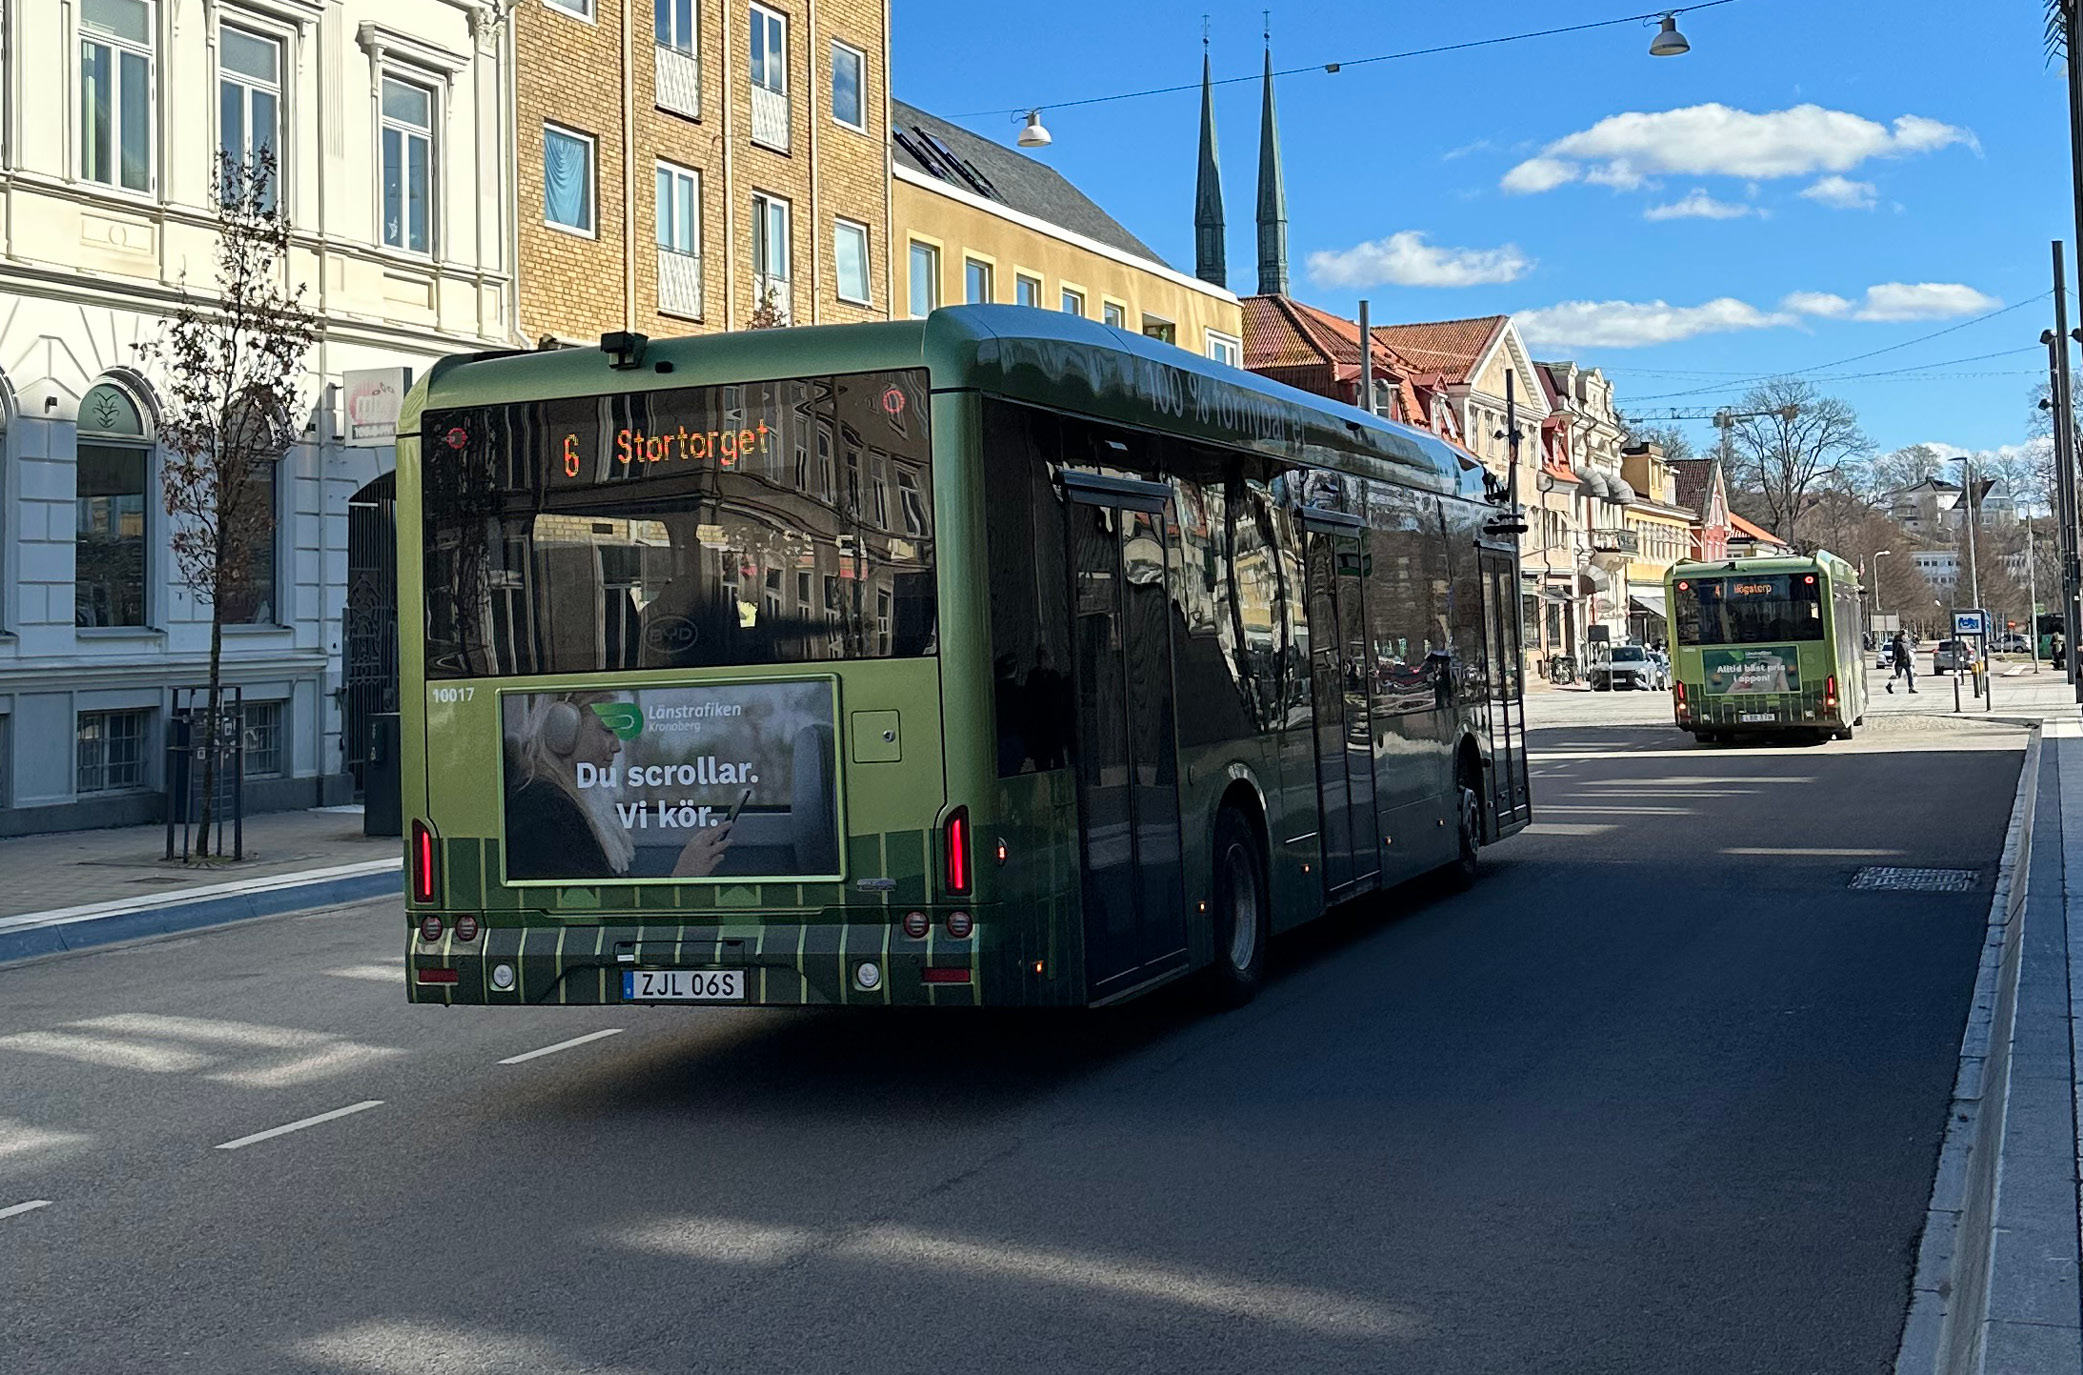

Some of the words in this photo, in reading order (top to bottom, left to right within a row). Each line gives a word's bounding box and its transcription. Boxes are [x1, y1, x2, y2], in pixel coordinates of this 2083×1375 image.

[1145, 361, 1183, 418] 100
[1188, 372, 1209, 424] %
[563, 433, 579, 478] 6
[617, 418, 768, 466] Stortorget
[649, 627, 692, 642] BYD
[432, 686, 475, 703] 10017
[648, 702, 742, 720] Länstrafiken
[648, 721, 701, 733] Kronoberg
[576, 761, 617, 789] Du
[627, 756, 759, 787] scrollar.
[616, 800, 648, 829] Vi
[658, 799, 718, 828] kör.
[642, 973, 683, 996] ZJL
[691, 973, 734, 996] 06S
